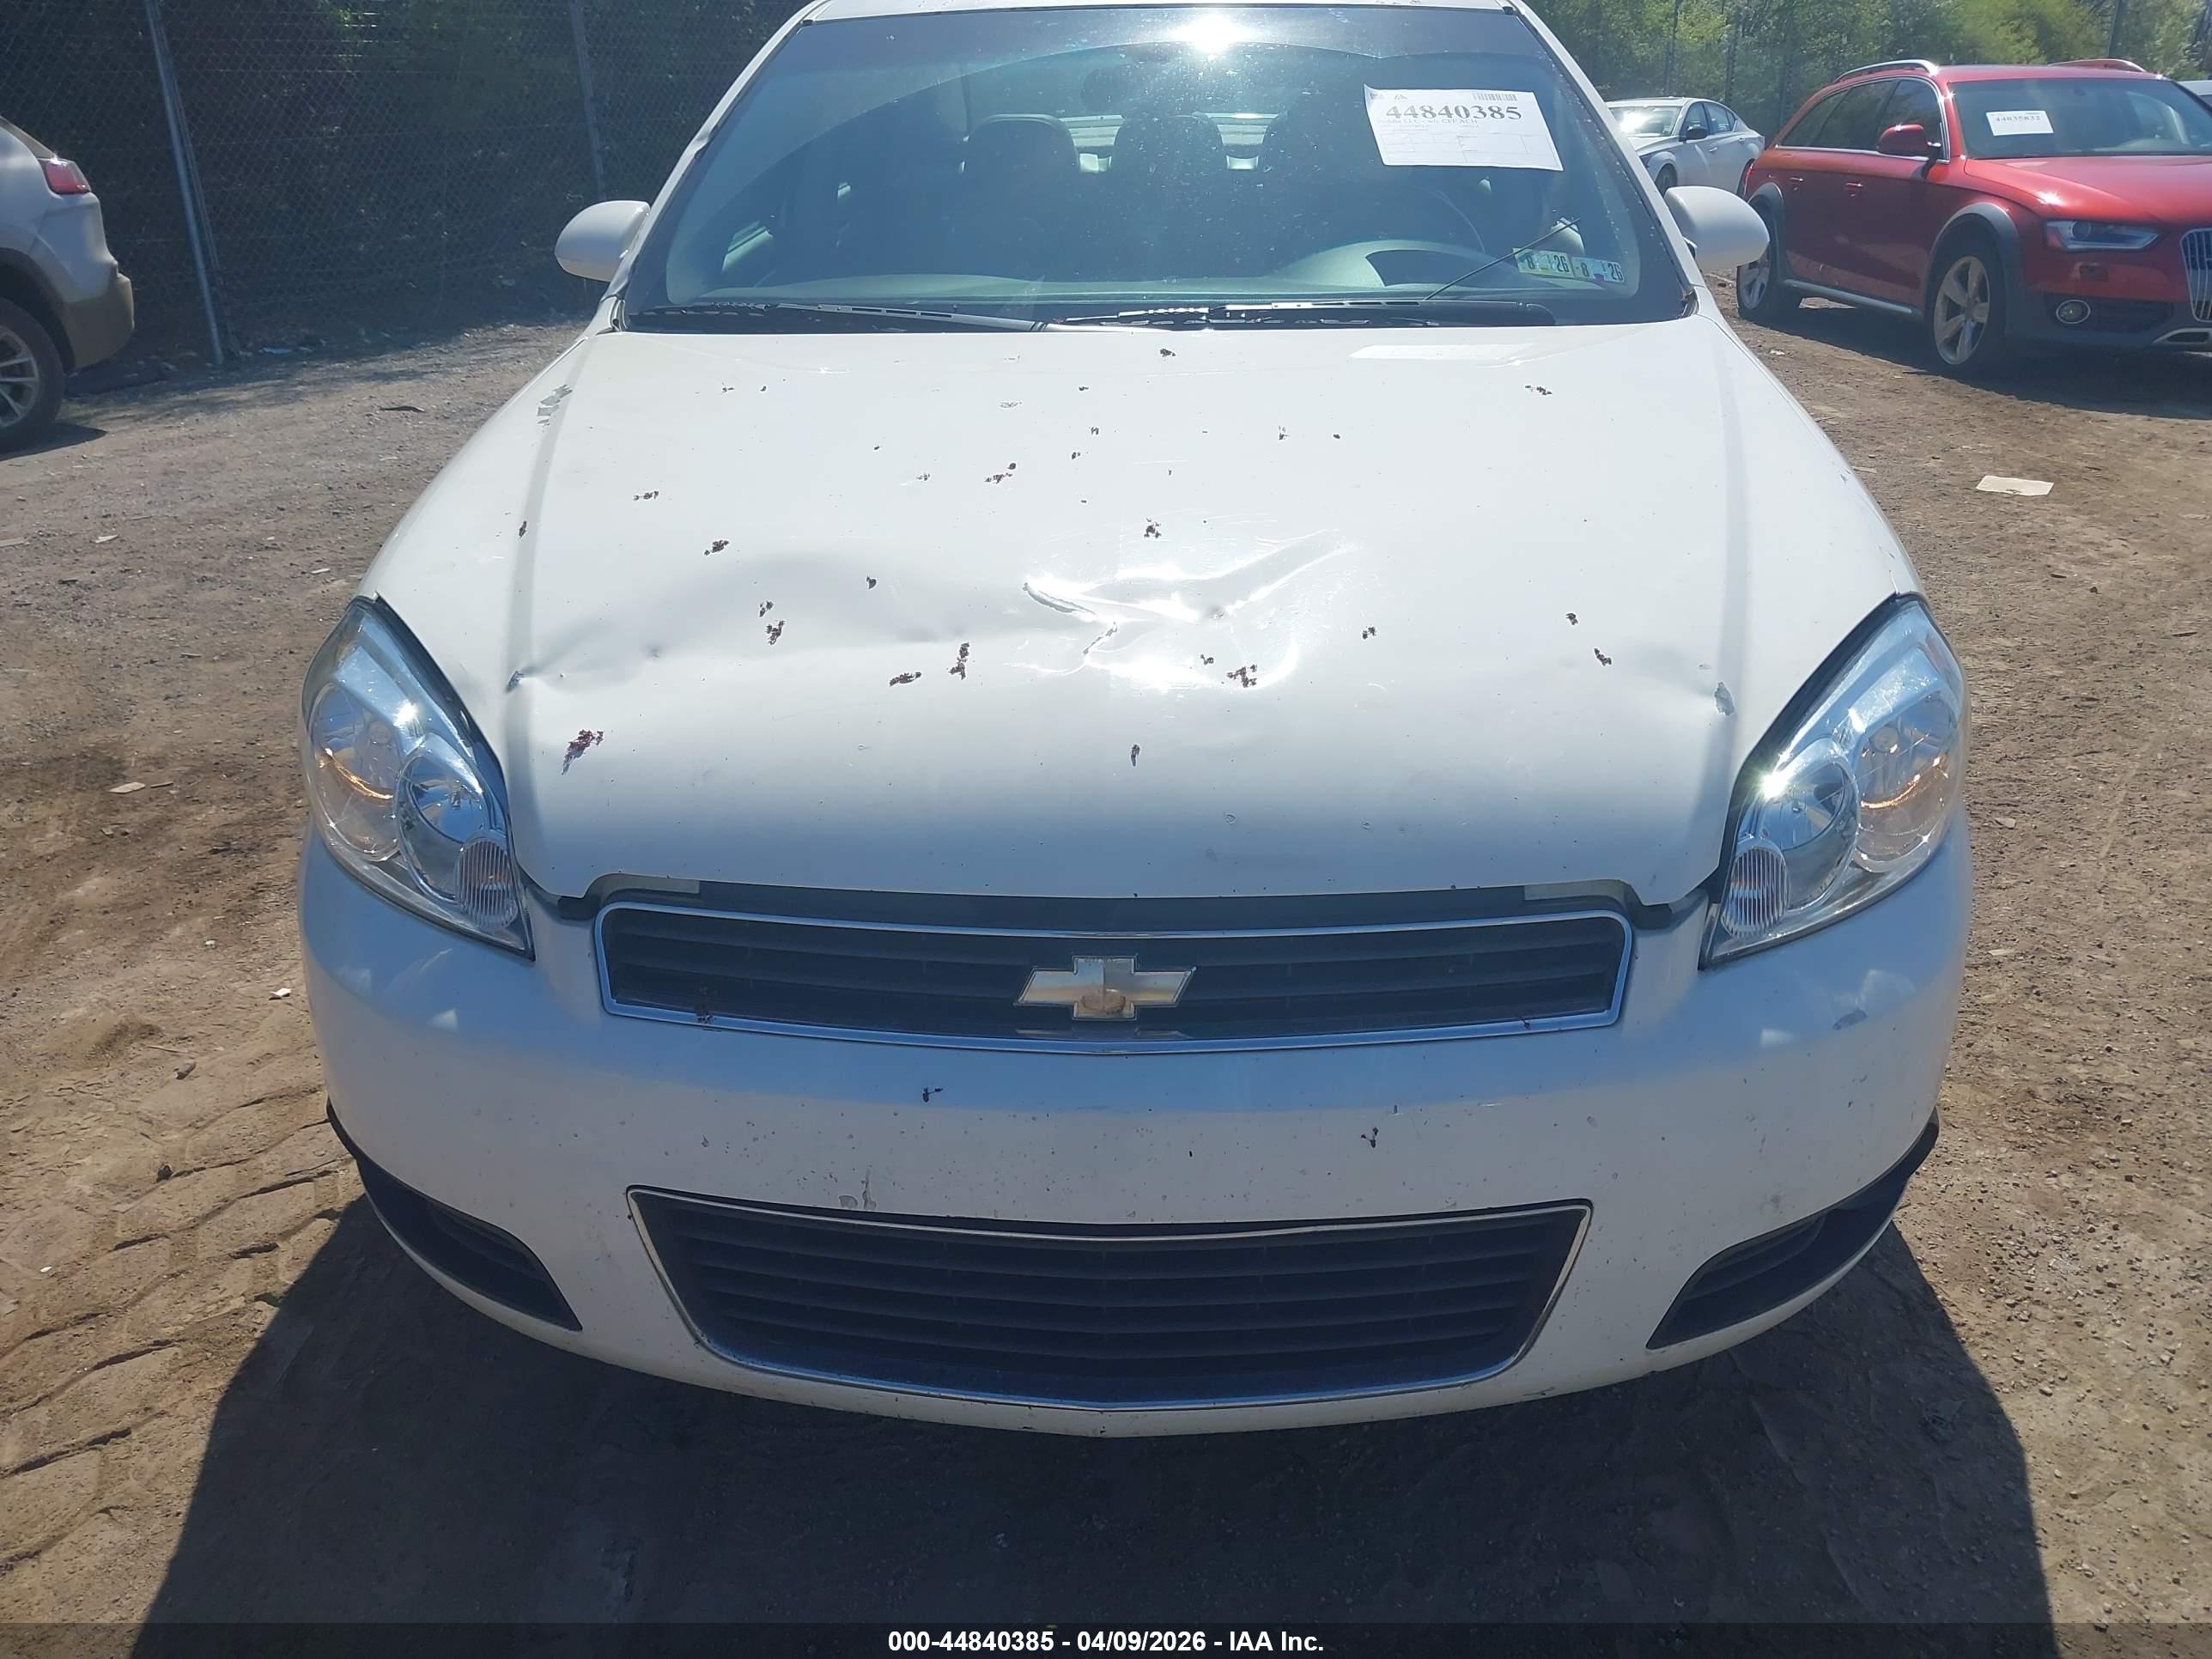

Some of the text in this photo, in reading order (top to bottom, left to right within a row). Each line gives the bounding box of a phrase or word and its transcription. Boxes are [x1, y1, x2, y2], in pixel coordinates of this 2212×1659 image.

[1386, 105, 1522, 120] 44840385
[1553, 254, 1570, 273] 26
[1607, 262, 1624, 282] 26
